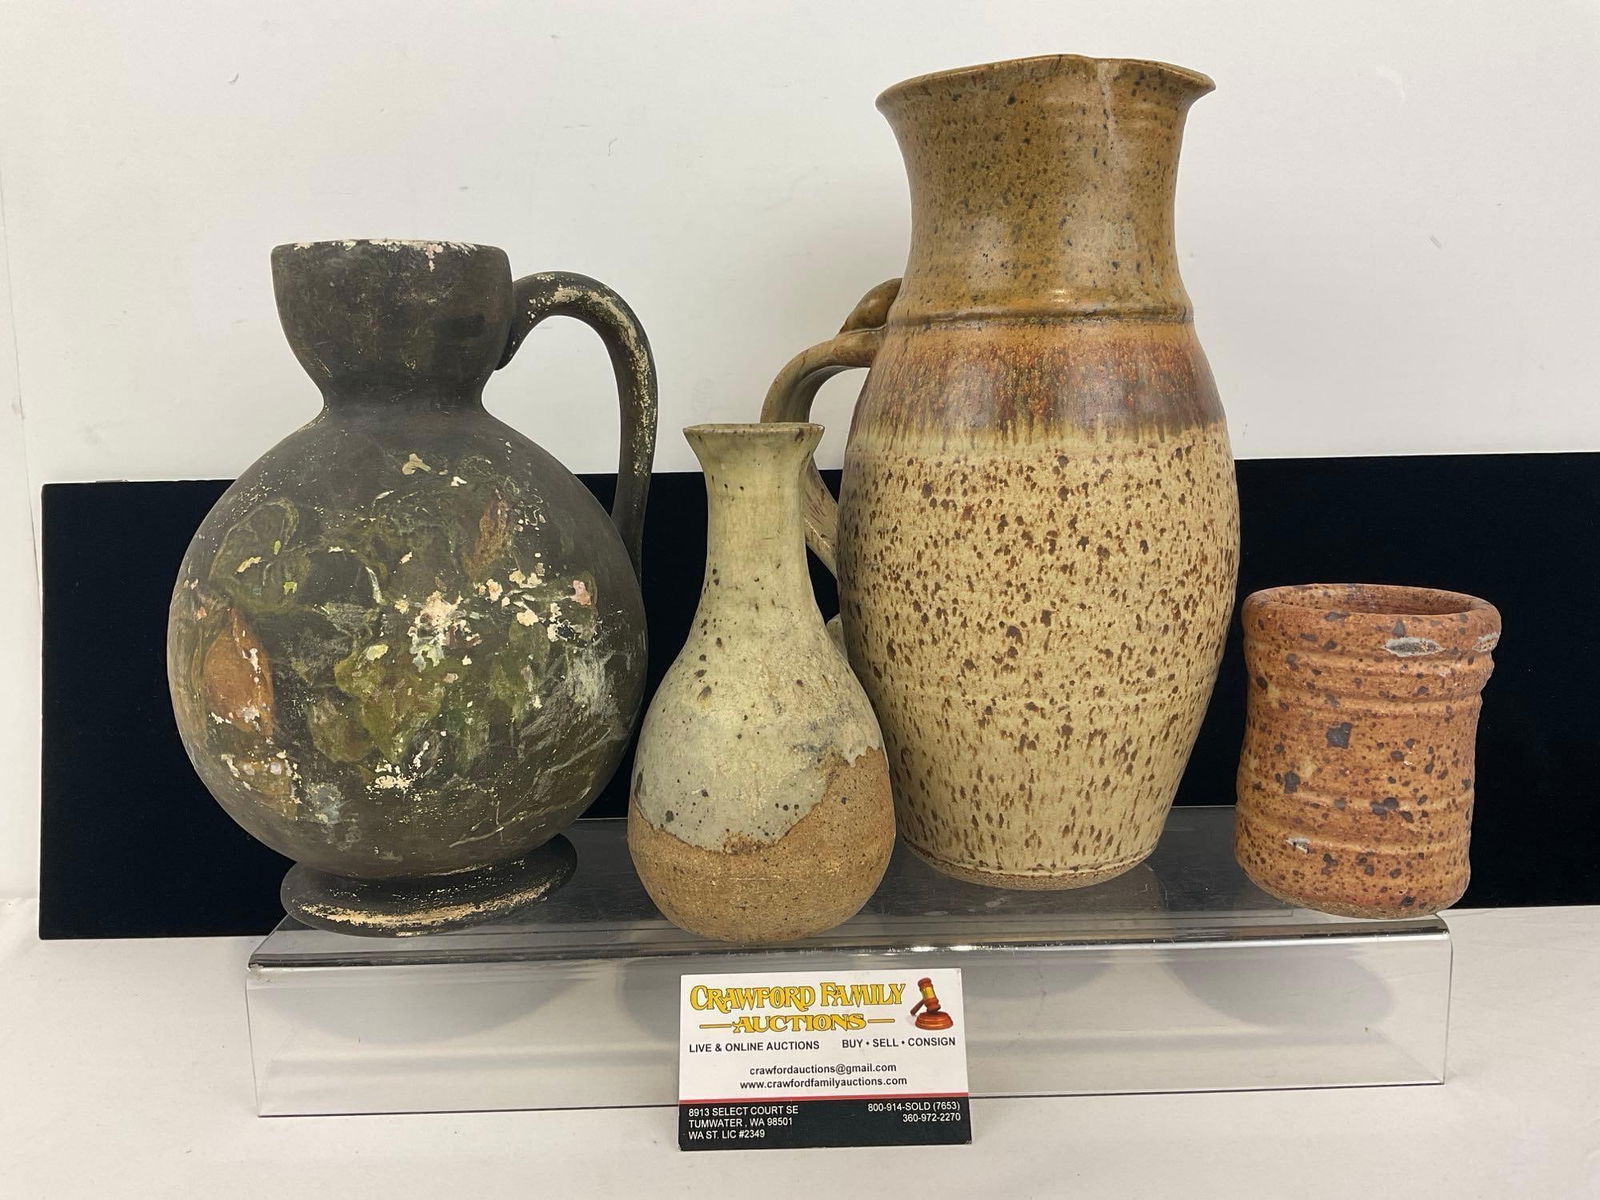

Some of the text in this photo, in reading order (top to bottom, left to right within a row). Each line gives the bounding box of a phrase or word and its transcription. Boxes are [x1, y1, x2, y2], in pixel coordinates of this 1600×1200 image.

[690, 982, 906, 1013] CRAWFORD FAMILY
[732, 1013, 866, 1033] AUCTIONS
[689, 1040, 820, 1053] LIVE & ONLINE AUCTIONS
[842, 1037, 956, 1048] BUY SELL CONSIGN
[749, 1064, 897, 1075] crawfordauctions@gmail.com
[740, 1077, 908, 1088] www.crawfordfamilyauctions.com
[688, 1105, 799, 1117] 8913 SELECT COURT SE
[868, 1101, 960, 1112] 800-914-SOLD (7653)
[749, 1118, 765, 1127] WA
[767, 1117, 793, 1126] 98501
[902, 1113, 961, 1122] 360-972-2270
[688, 1129, 765, 1140] WA ST. LIC #2349
